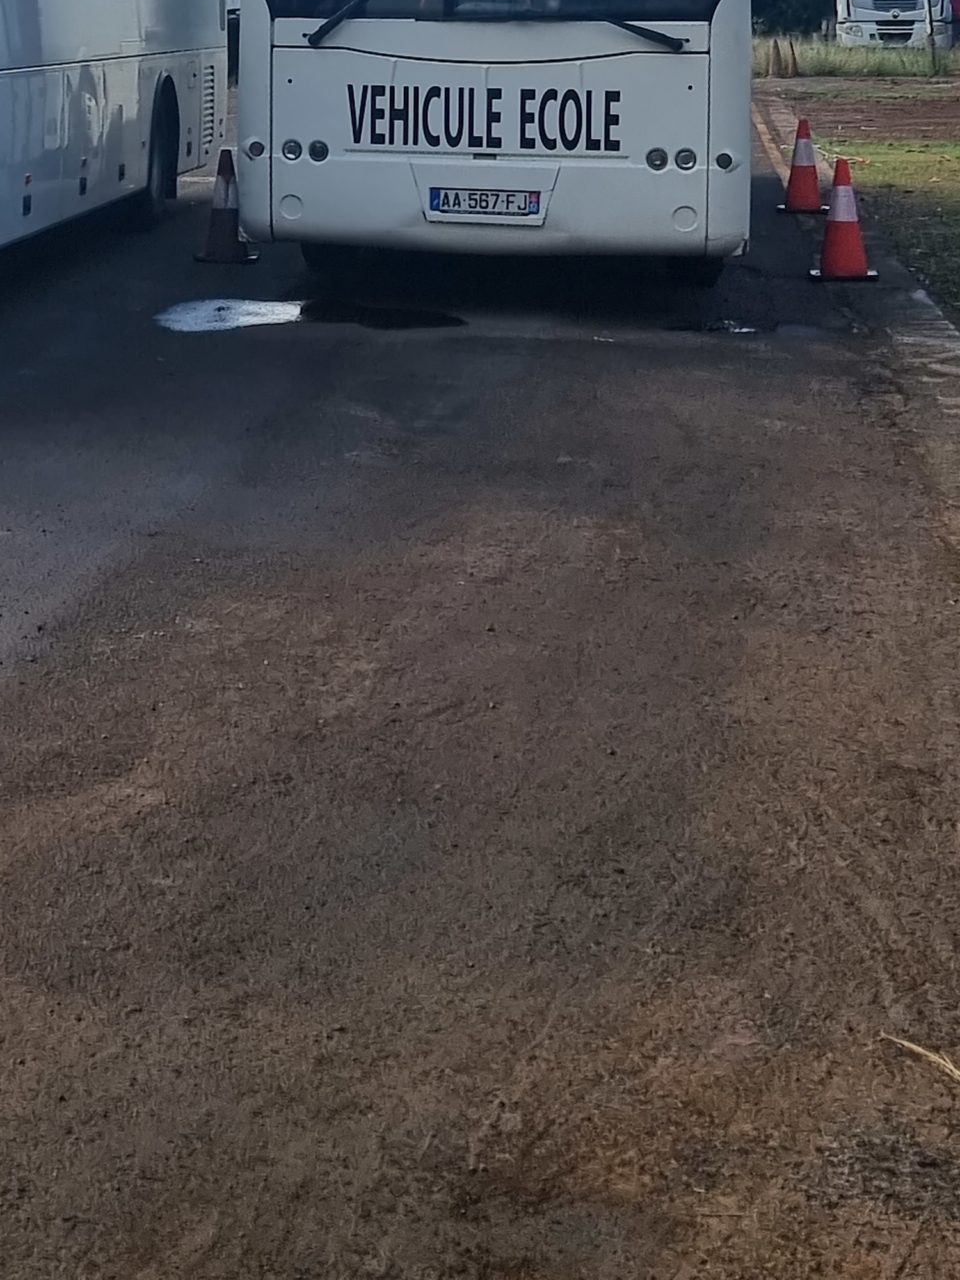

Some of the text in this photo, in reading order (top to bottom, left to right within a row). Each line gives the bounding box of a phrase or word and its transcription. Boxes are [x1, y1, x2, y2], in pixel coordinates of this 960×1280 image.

[347, 84, 621, 151] VEHICULE ECOLE
[441, 191, 528, 211] AA-567-FJ
